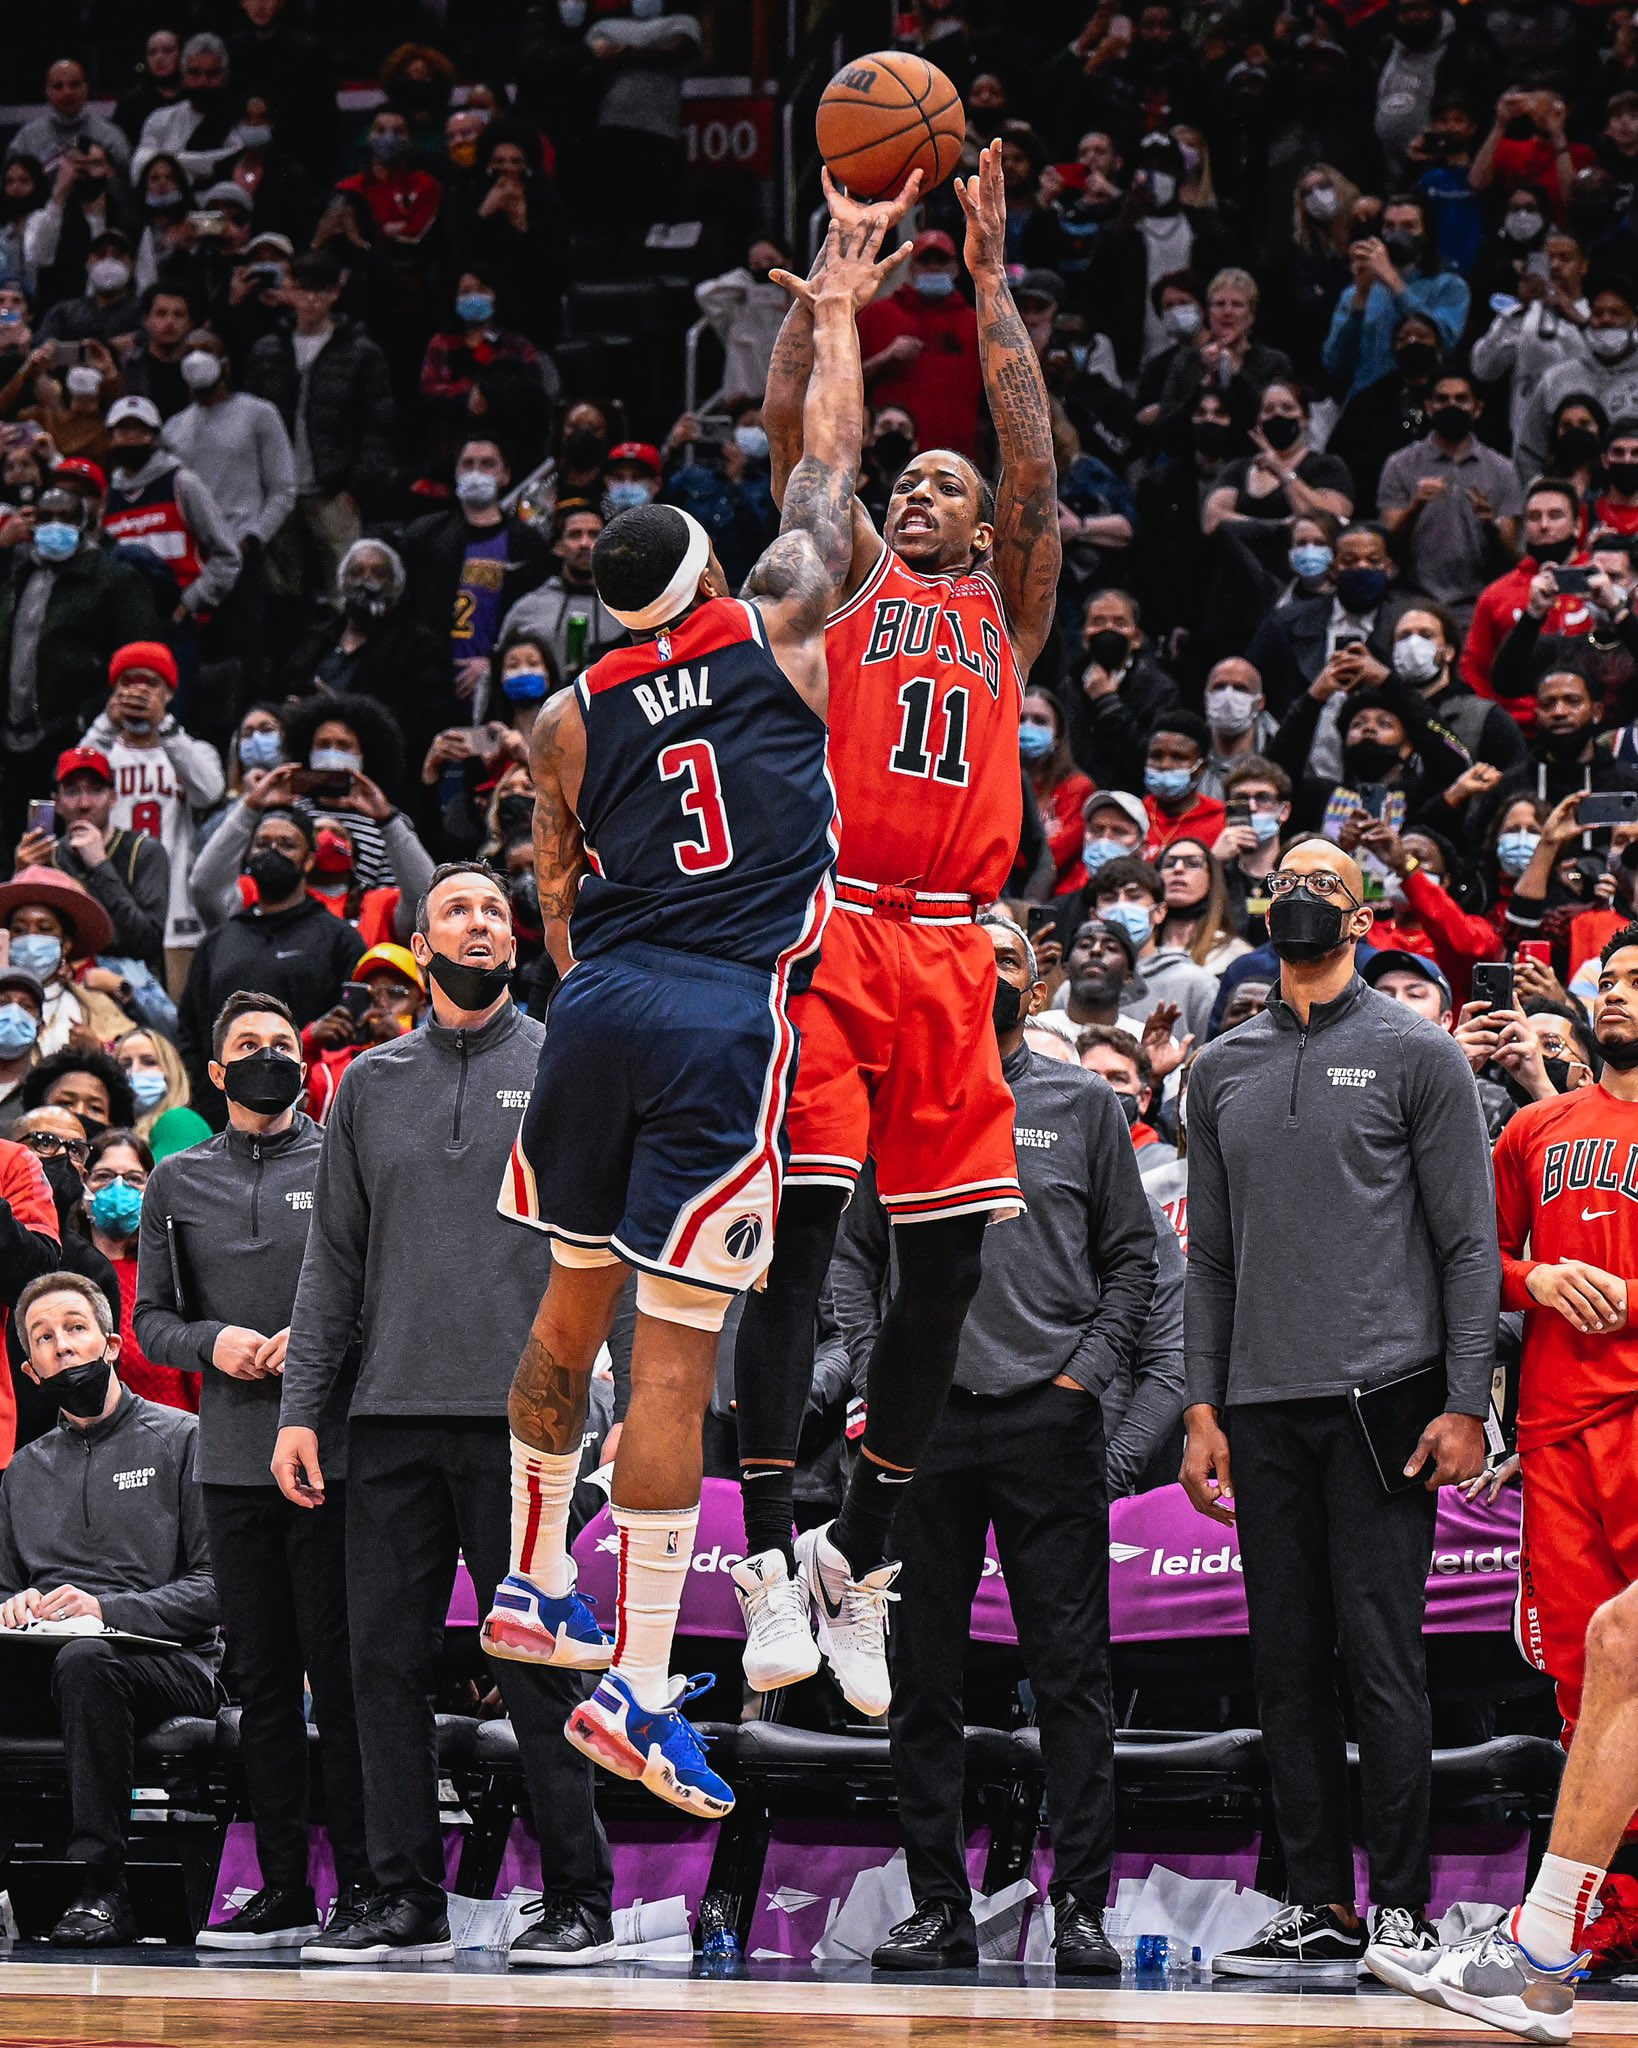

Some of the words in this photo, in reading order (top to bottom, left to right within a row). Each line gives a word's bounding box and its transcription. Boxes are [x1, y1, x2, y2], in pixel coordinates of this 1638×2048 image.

[683, 120, 758, 161] 100
[632, 666, 713, 726] BEAL
[889, 676, 970, 788] 11
[657, 738, 734, 876] 3
[1326, 1067, 1377, 1079] CHICAGO
[1331, 1077, 1367, 1088] BULLS
[285, 1191, 314, 1202] CHIC
[112, 1467, 156, 1482] CHICAGO
[118, 1477, 149, 1491] BULLS
[1527, 1606, 1546, 1671] BULLS
